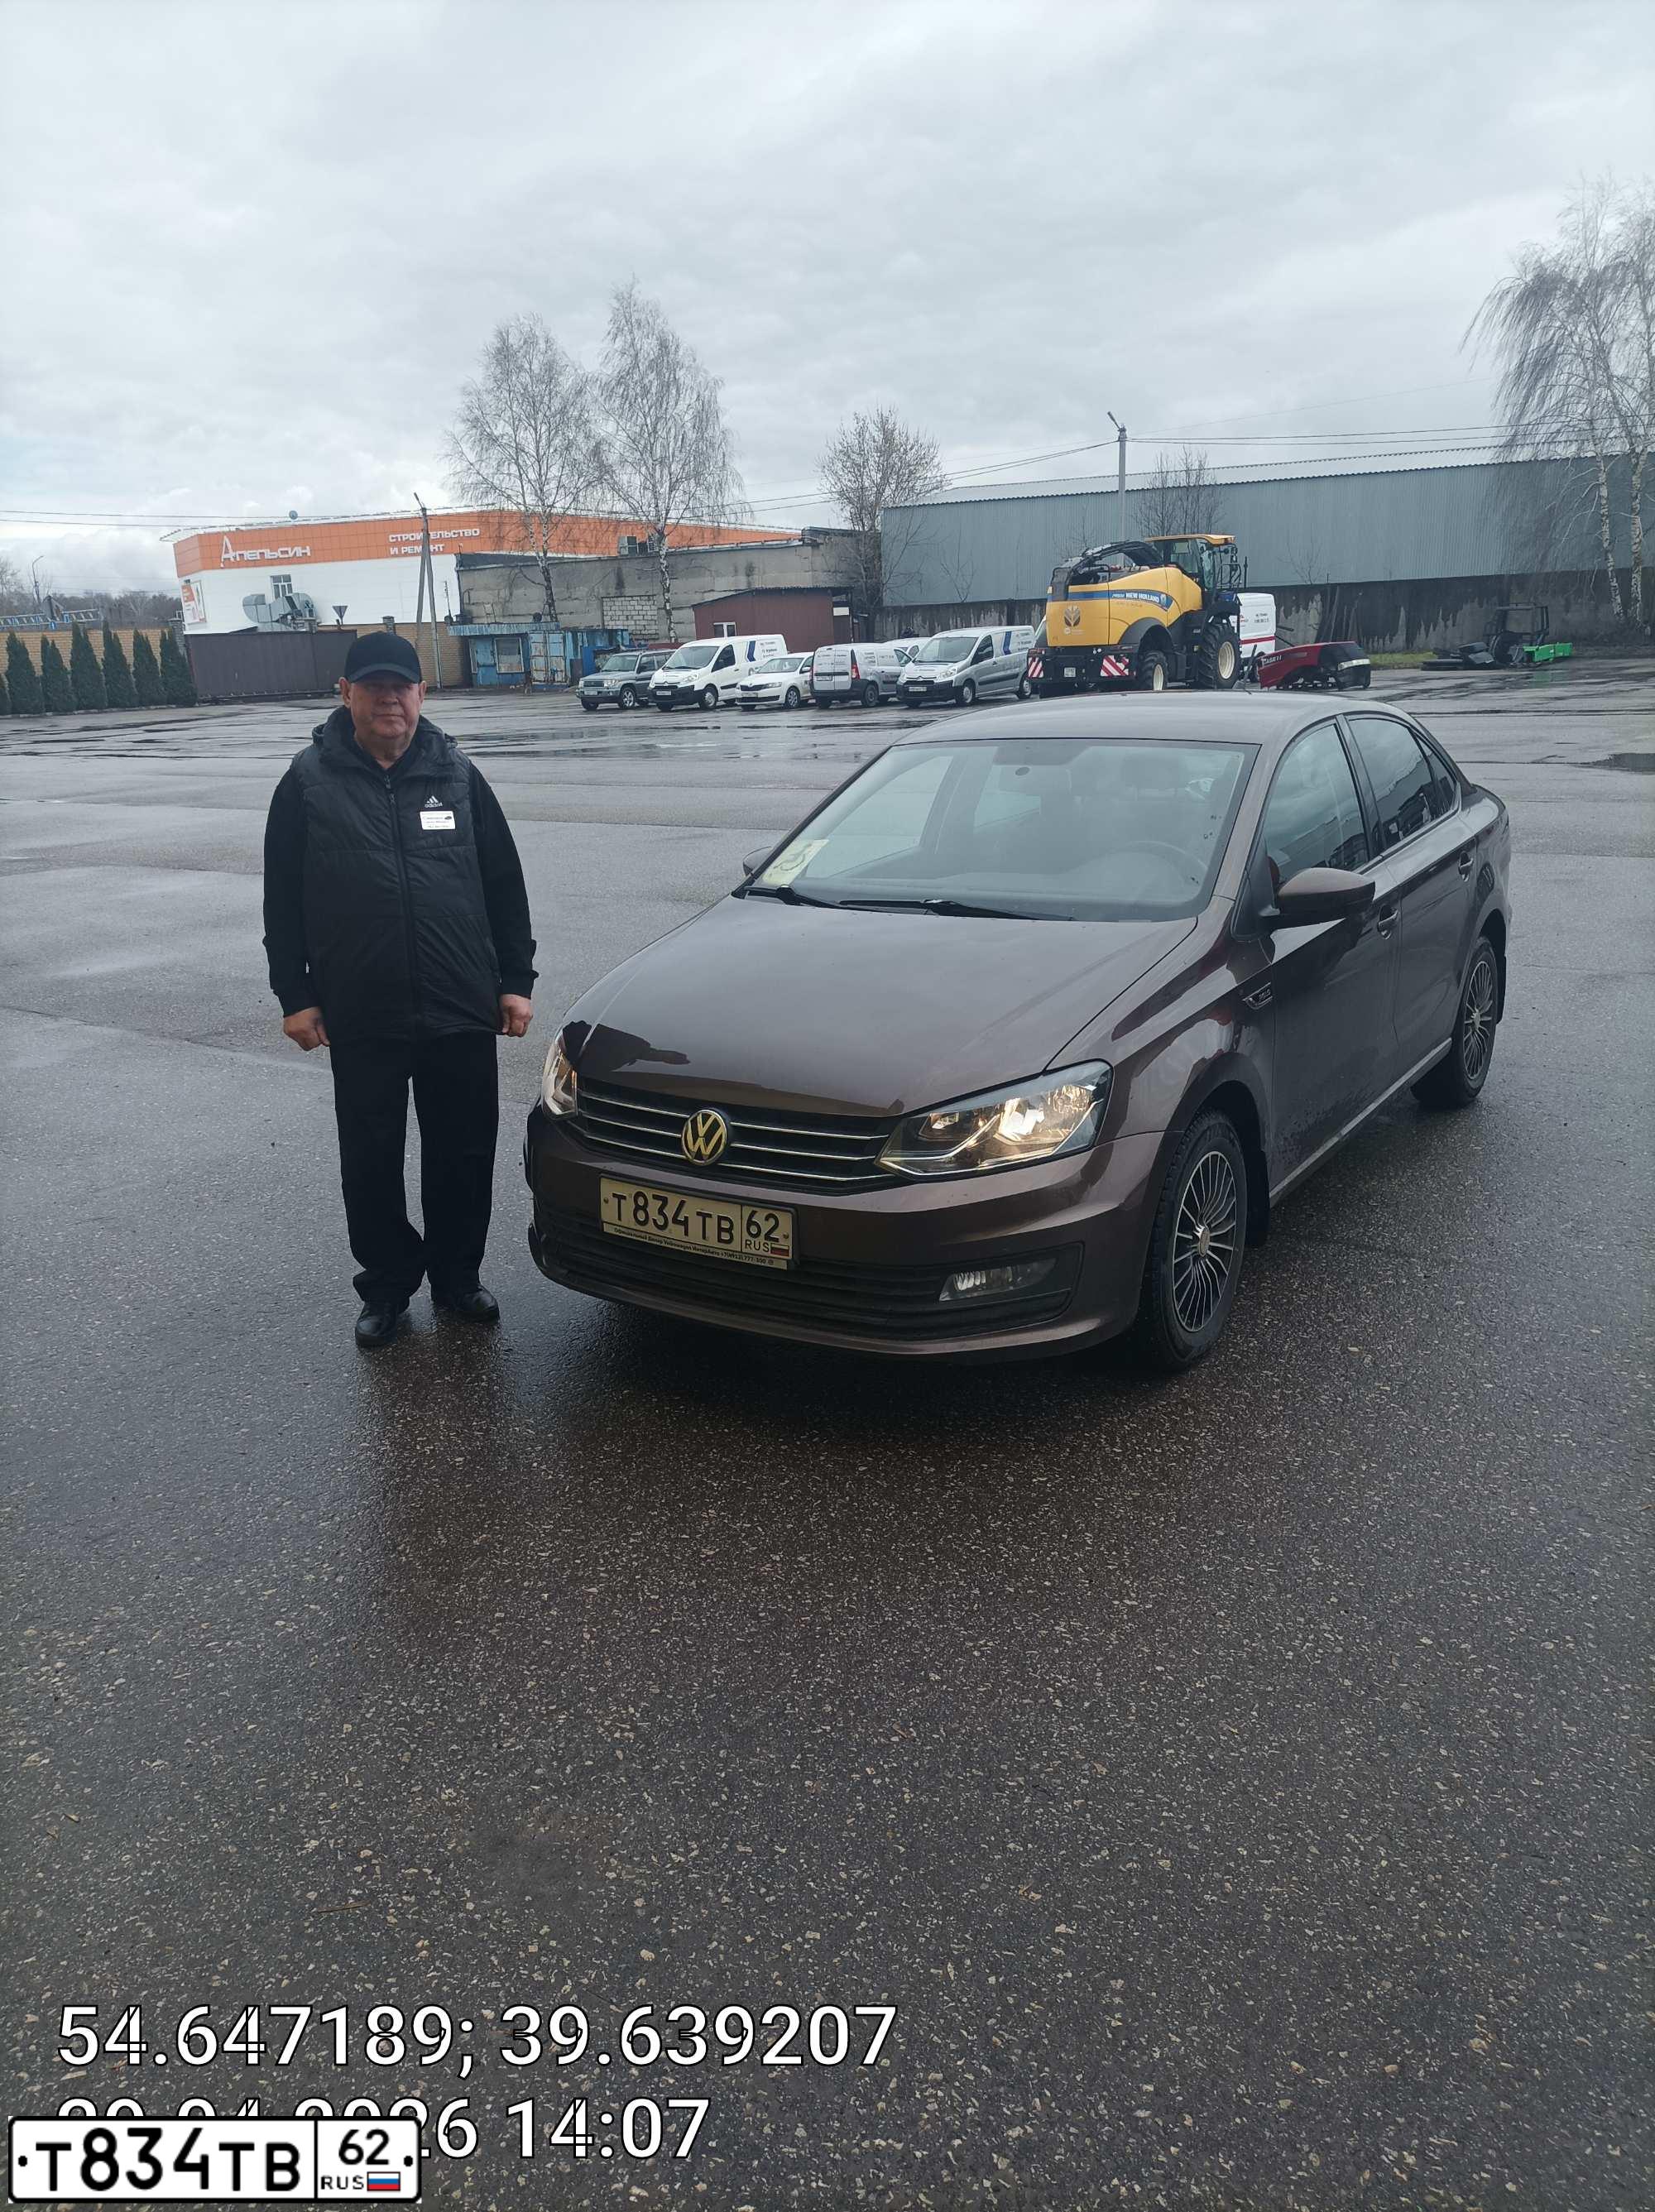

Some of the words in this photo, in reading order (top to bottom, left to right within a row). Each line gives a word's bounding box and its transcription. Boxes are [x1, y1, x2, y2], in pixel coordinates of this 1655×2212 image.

[389, 528, 480, 543] СТРОИЕЛЬСТВО
[401, 544, 444, 554] РЕМНТ
[1139, 593, 1160, 603] HOLLAND
[612, 1191, 734, 1245] Т834ТВ
[746, 1210, 780, 1243] 62
[745, 1240, 770, 1253] RUS
